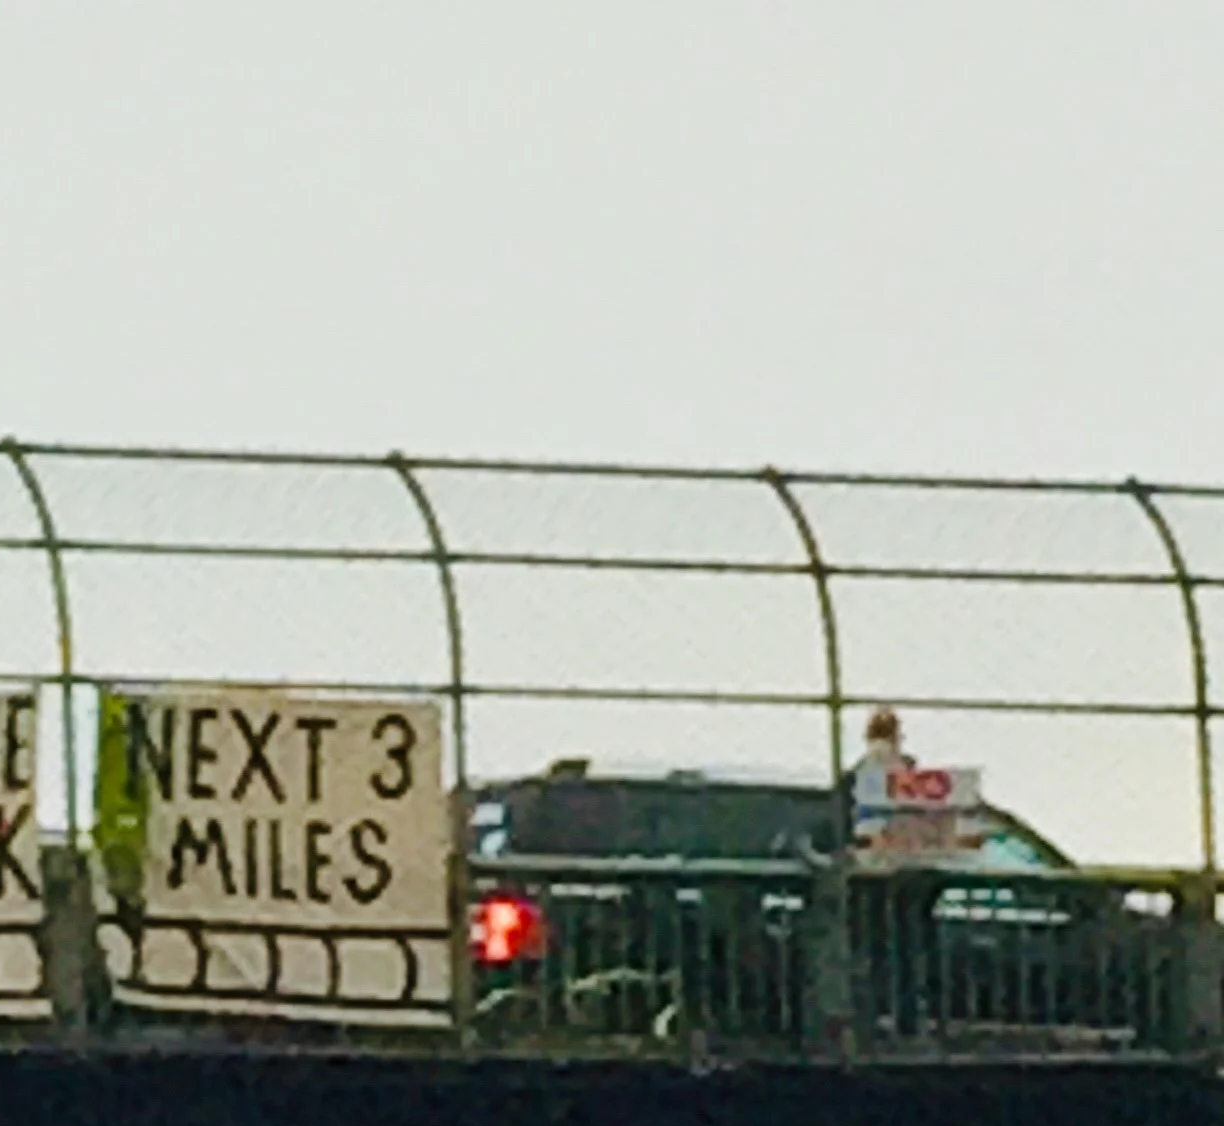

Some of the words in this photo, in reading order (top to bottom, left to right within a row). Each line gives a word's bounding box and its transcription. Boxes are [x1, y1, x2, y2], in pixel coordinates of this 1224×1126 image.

[128, 703, 337, 804] NEXT
[369, 713, 418, 800] 3
[887, 769, 953, 800] NO
[167, 818, 393, 905] MILES
